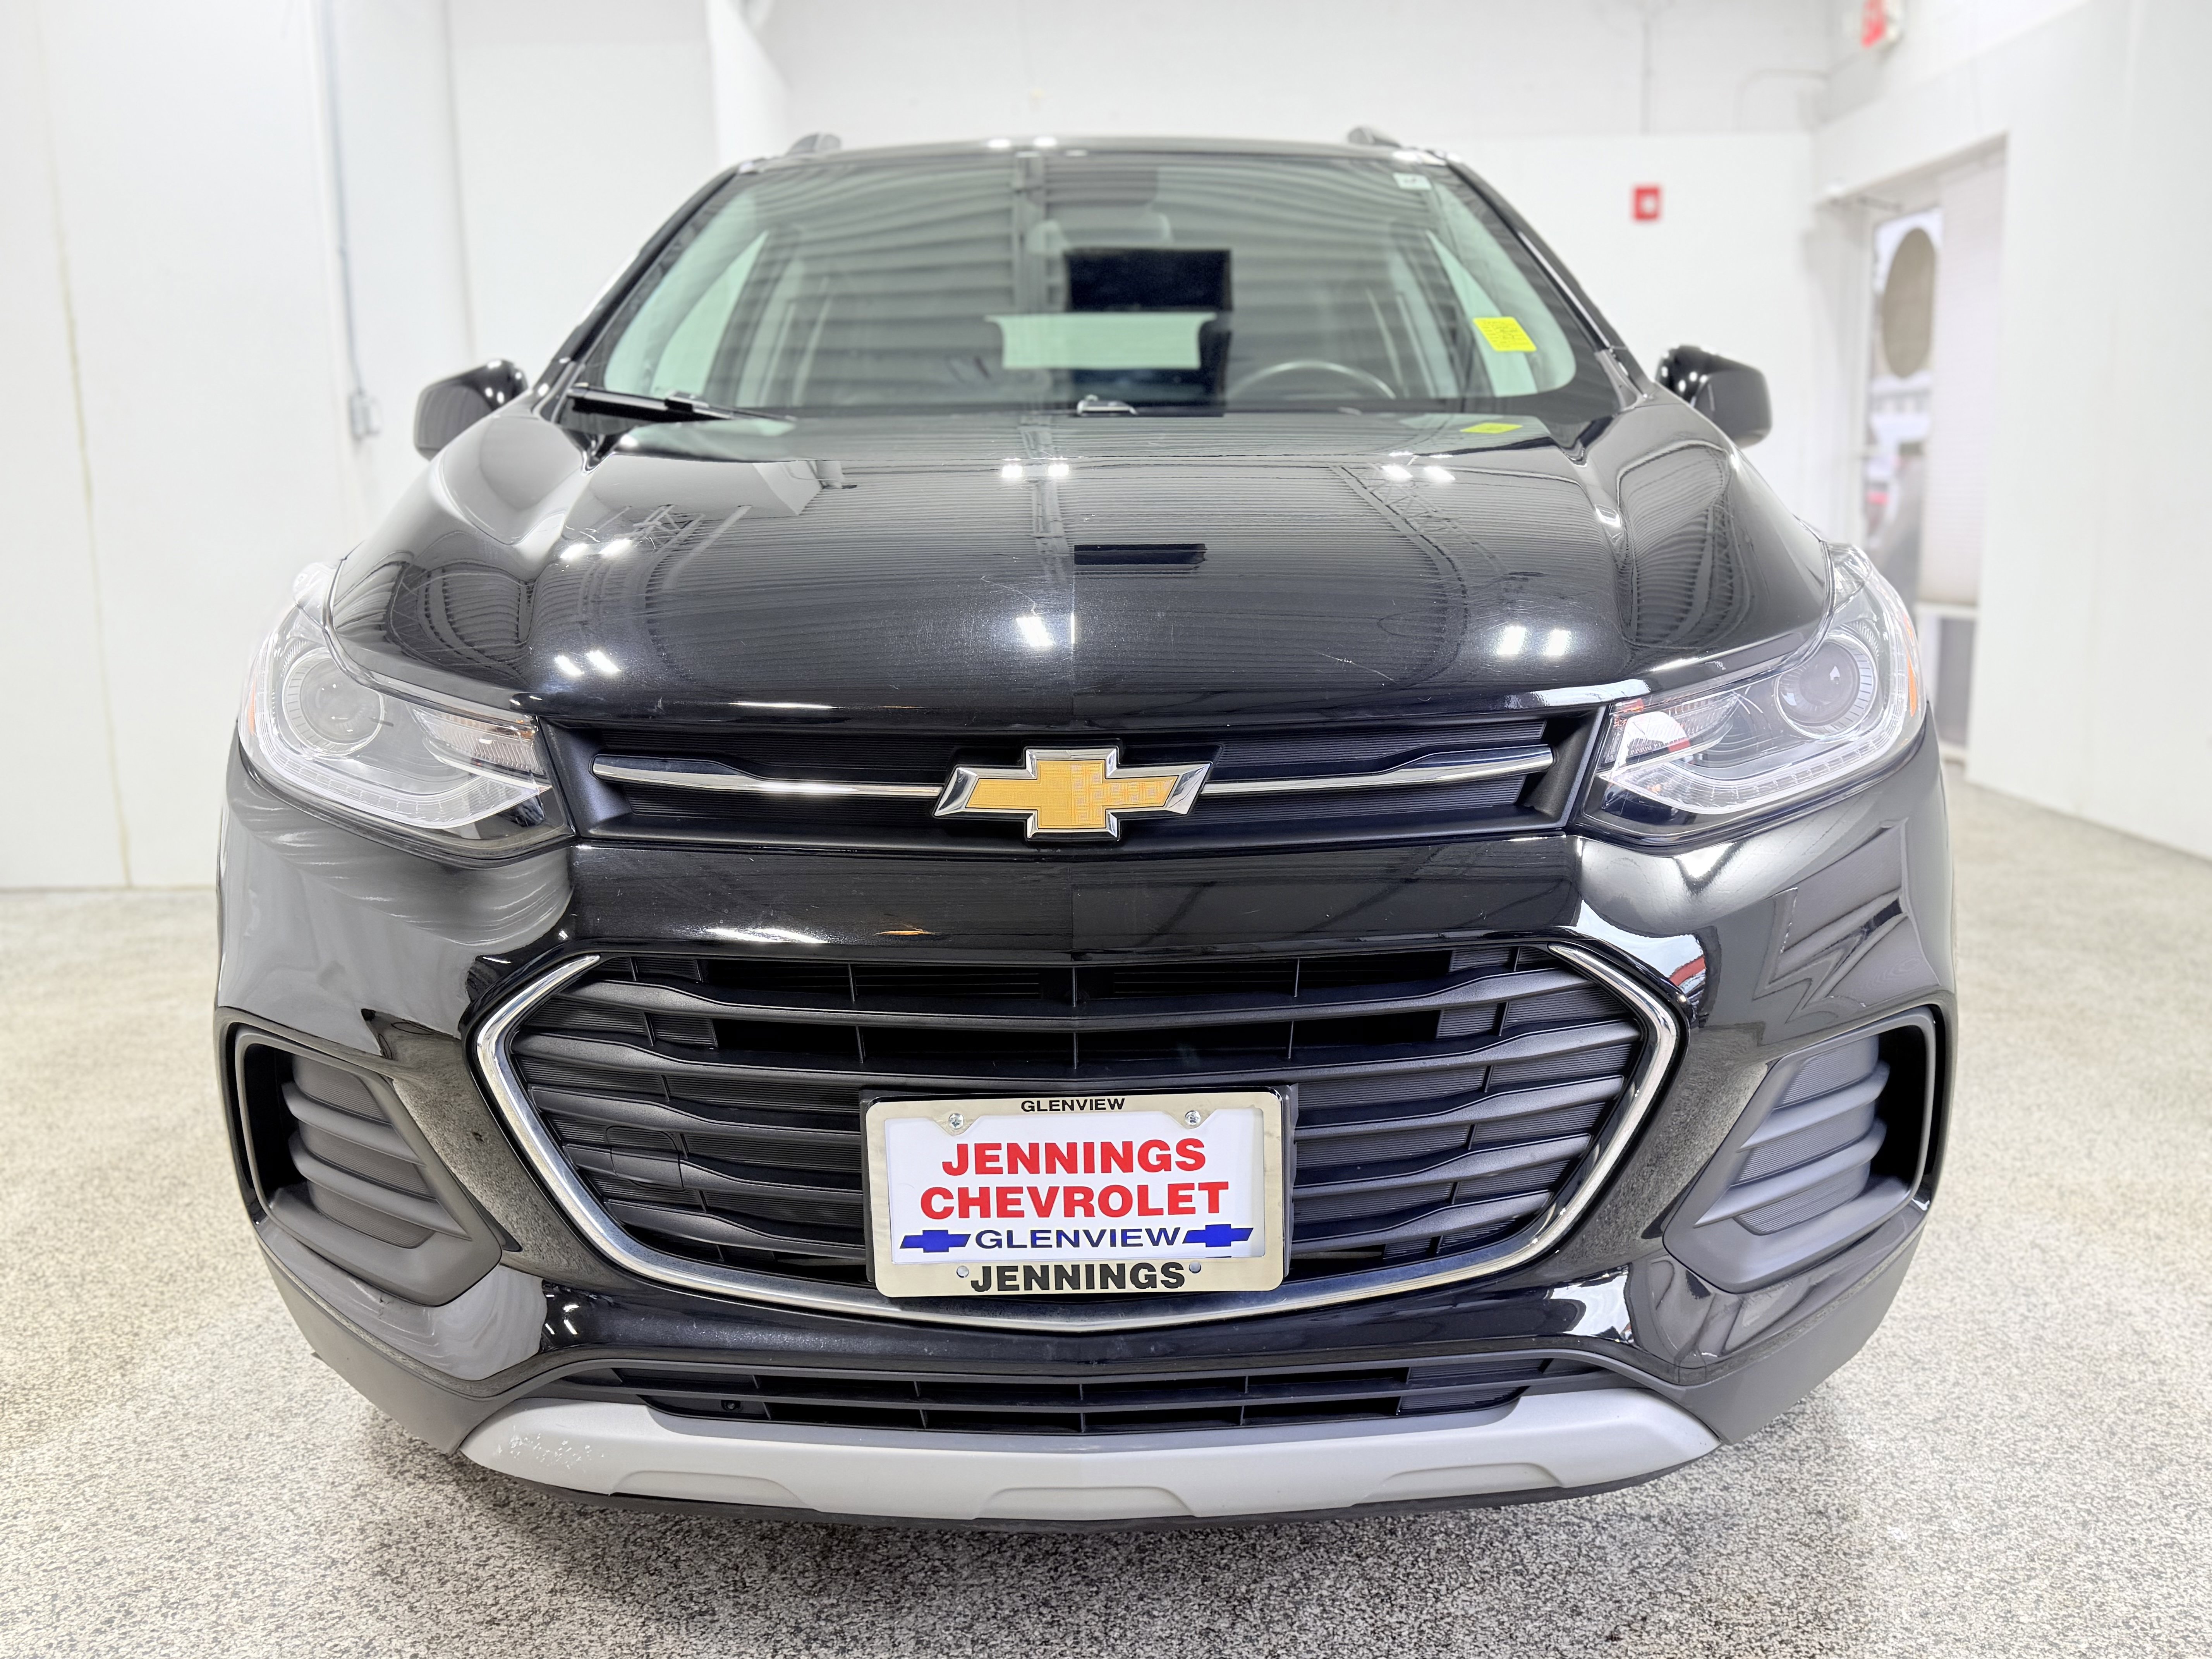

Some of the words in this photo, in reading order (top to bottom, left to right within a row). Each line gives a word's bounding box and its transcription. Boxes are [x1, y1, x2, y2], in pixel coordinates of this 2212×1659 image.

[1020, 1097, 1125, 1113] GLENVIEW
[941, 1138, 1206, 1176] JENNINGS
[920, 1181, 1229, 1220] CHEVROLET
[975, 1226, 1181, 1249] GLENVIEW
[970, 1261, 1185, 1293] JENNINGS
